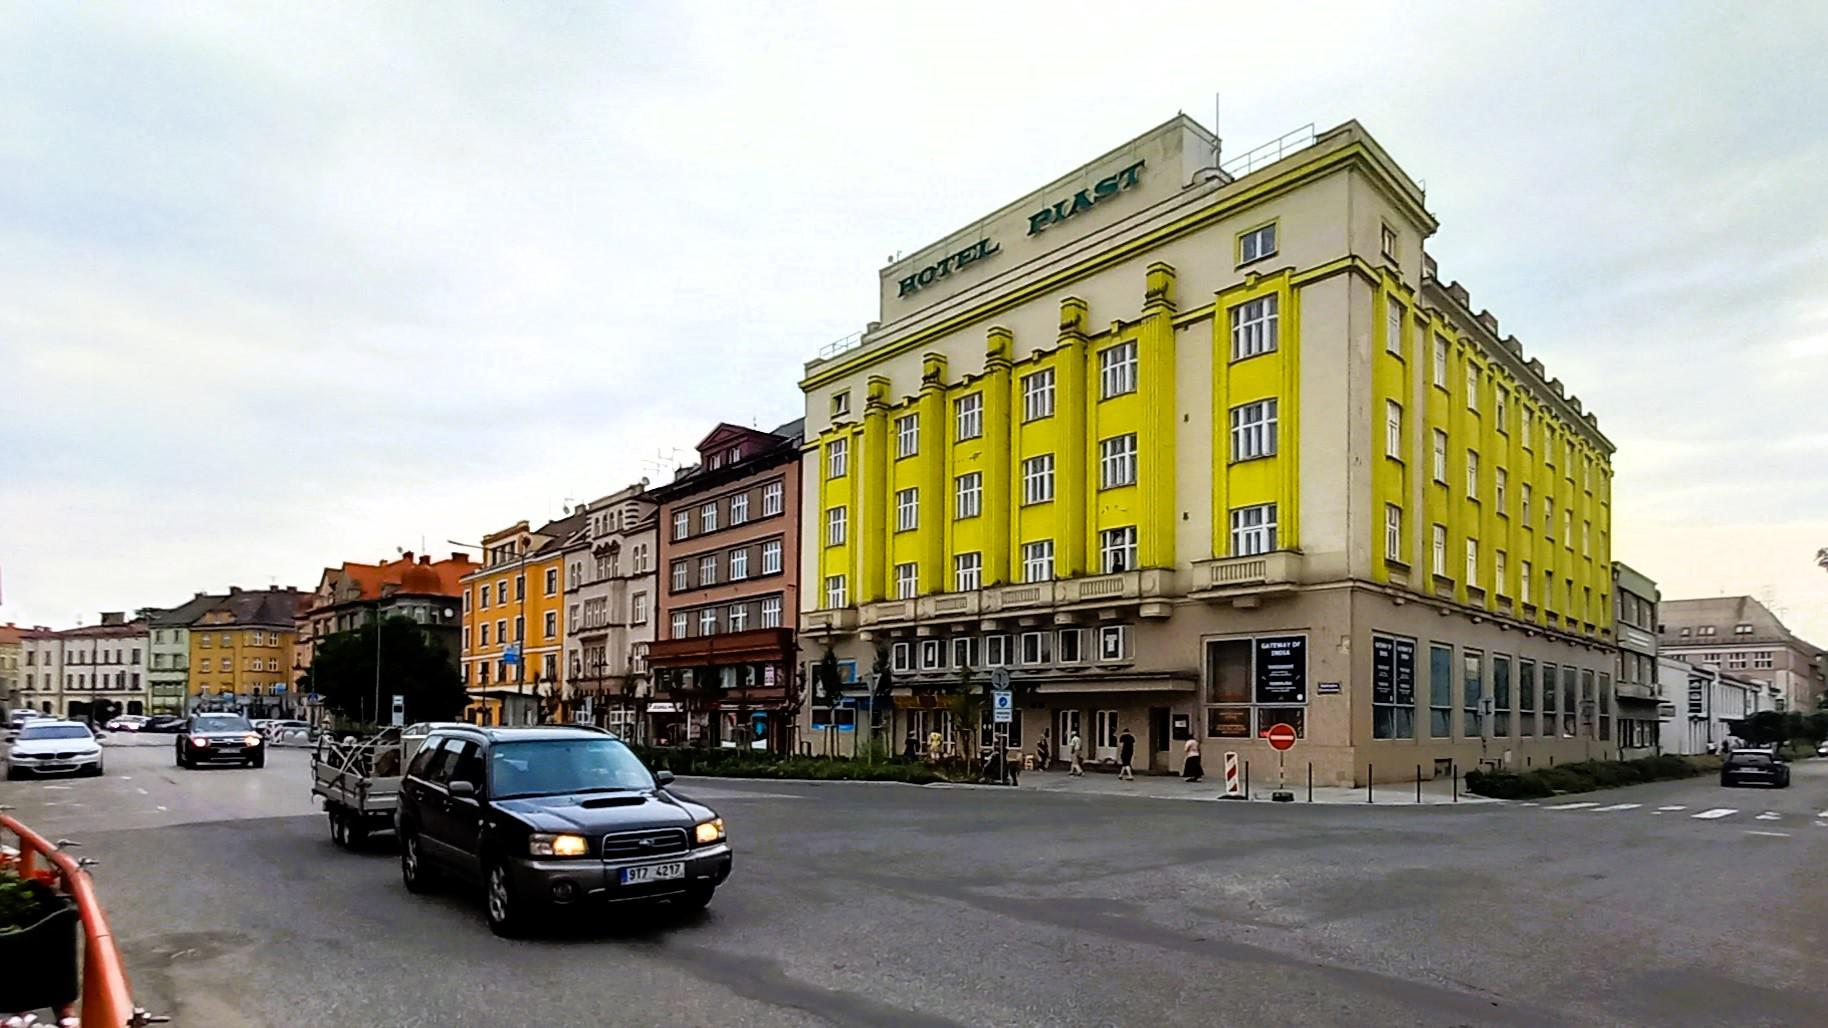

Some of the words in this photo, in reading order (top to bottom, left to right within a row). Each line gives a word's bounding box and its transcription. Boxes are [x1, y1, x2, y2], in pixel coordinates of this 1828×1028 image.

[897, 237, 1001, 298] HOTEL
[1026, 158, 1146, 237] PIAST
[656, 864, 680, 876] 4217
